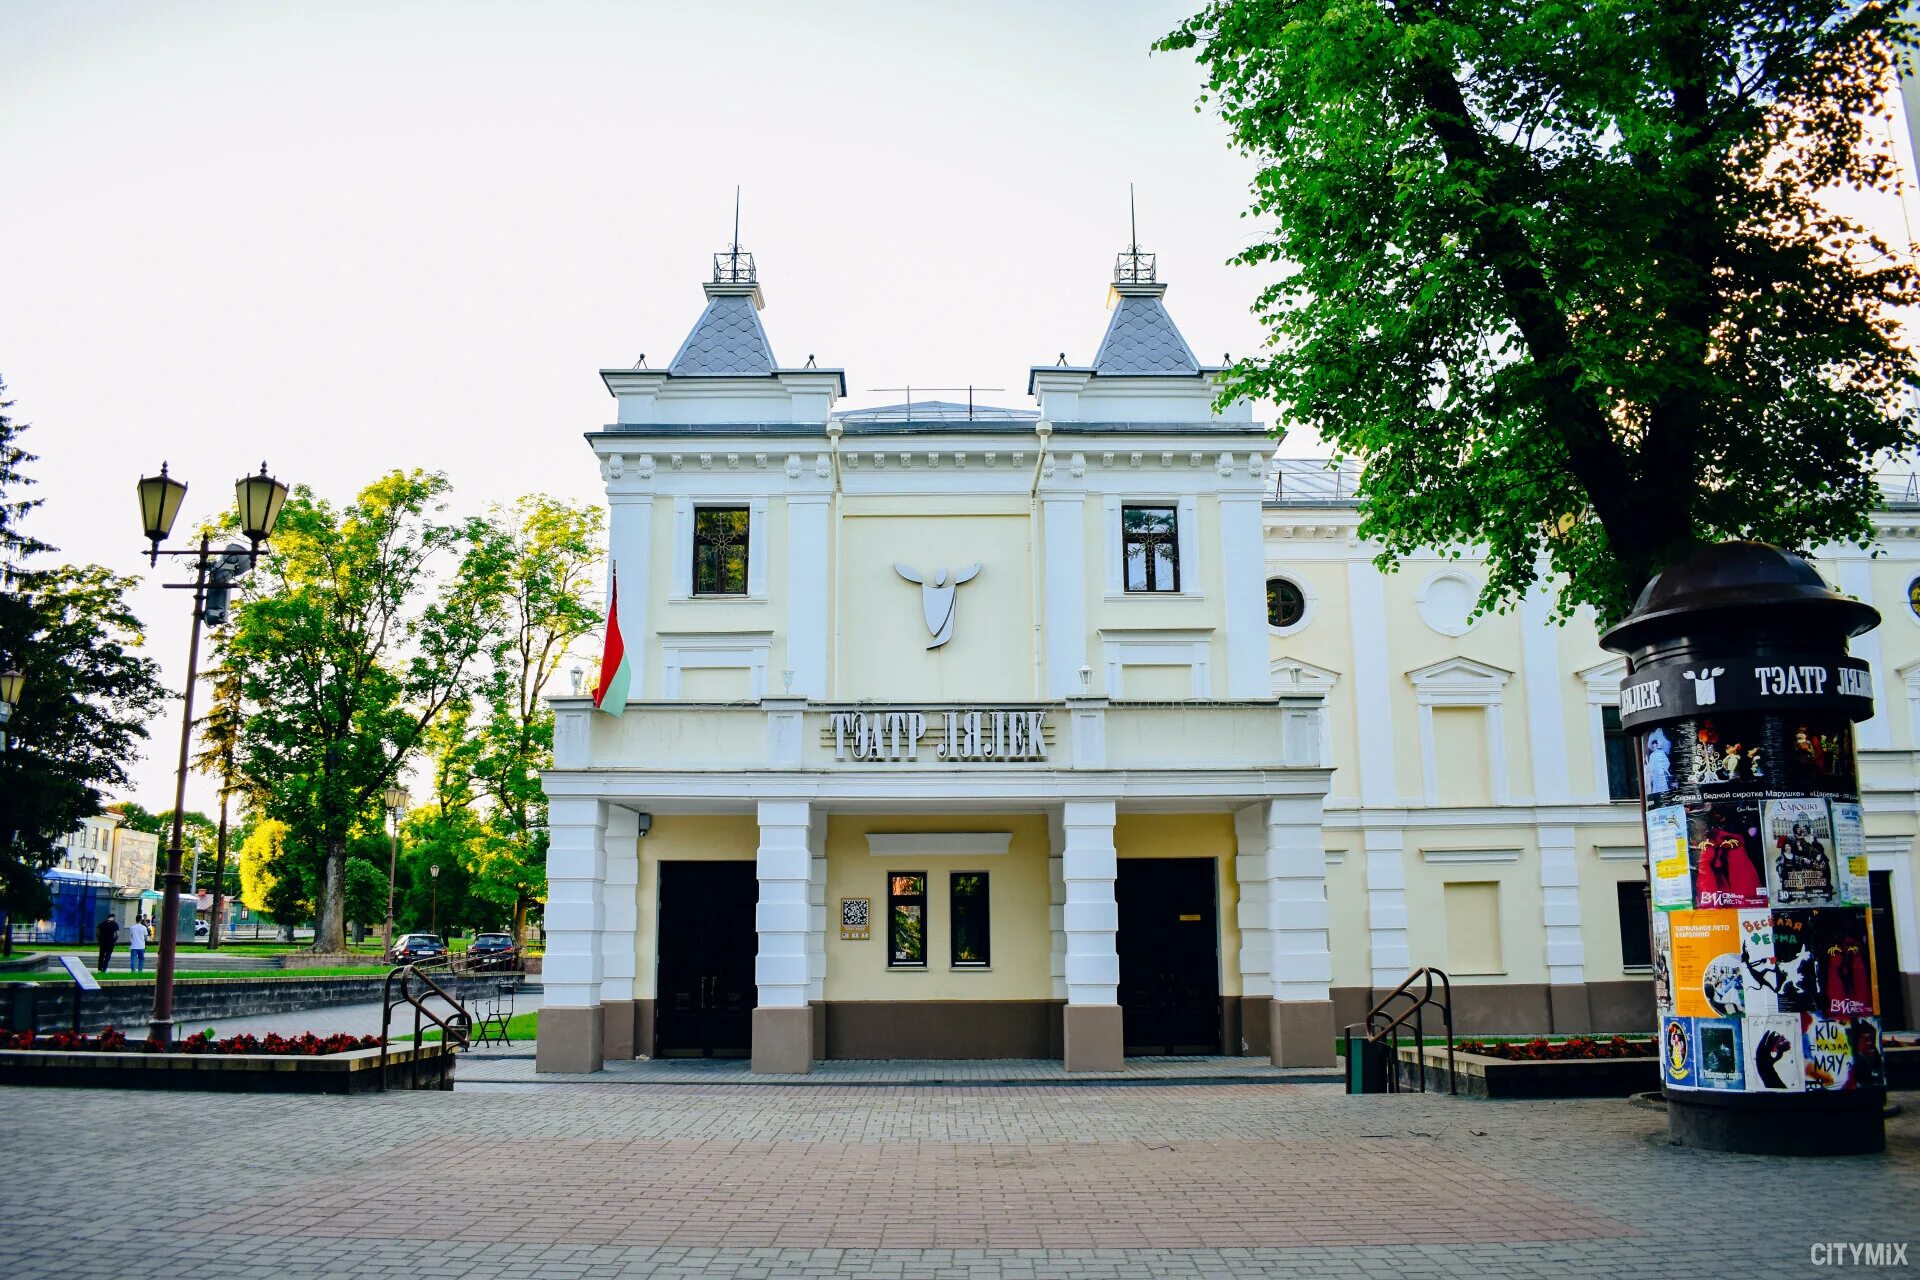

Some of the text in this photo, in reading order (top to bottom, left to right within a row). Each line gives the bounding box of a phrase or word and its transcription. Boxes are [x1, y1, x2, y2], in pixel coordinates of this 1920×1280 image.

[1755, 665, 1827, 696] ТЭАТР
[830, 711, 1049, 759] ТЭАТР ЛЯЛЕК
[1703, 791, 1731, 799] бедной
[1733, 791, 1764, 799] сиротке
[1778, 890, 1789, 899] 30
[1751, 933, 1798, 945] ФЕРМА
[1815, 1020, 1838, 1041] КТО
[1809, 1043, 1849, 1051] СКАЗАЛ
